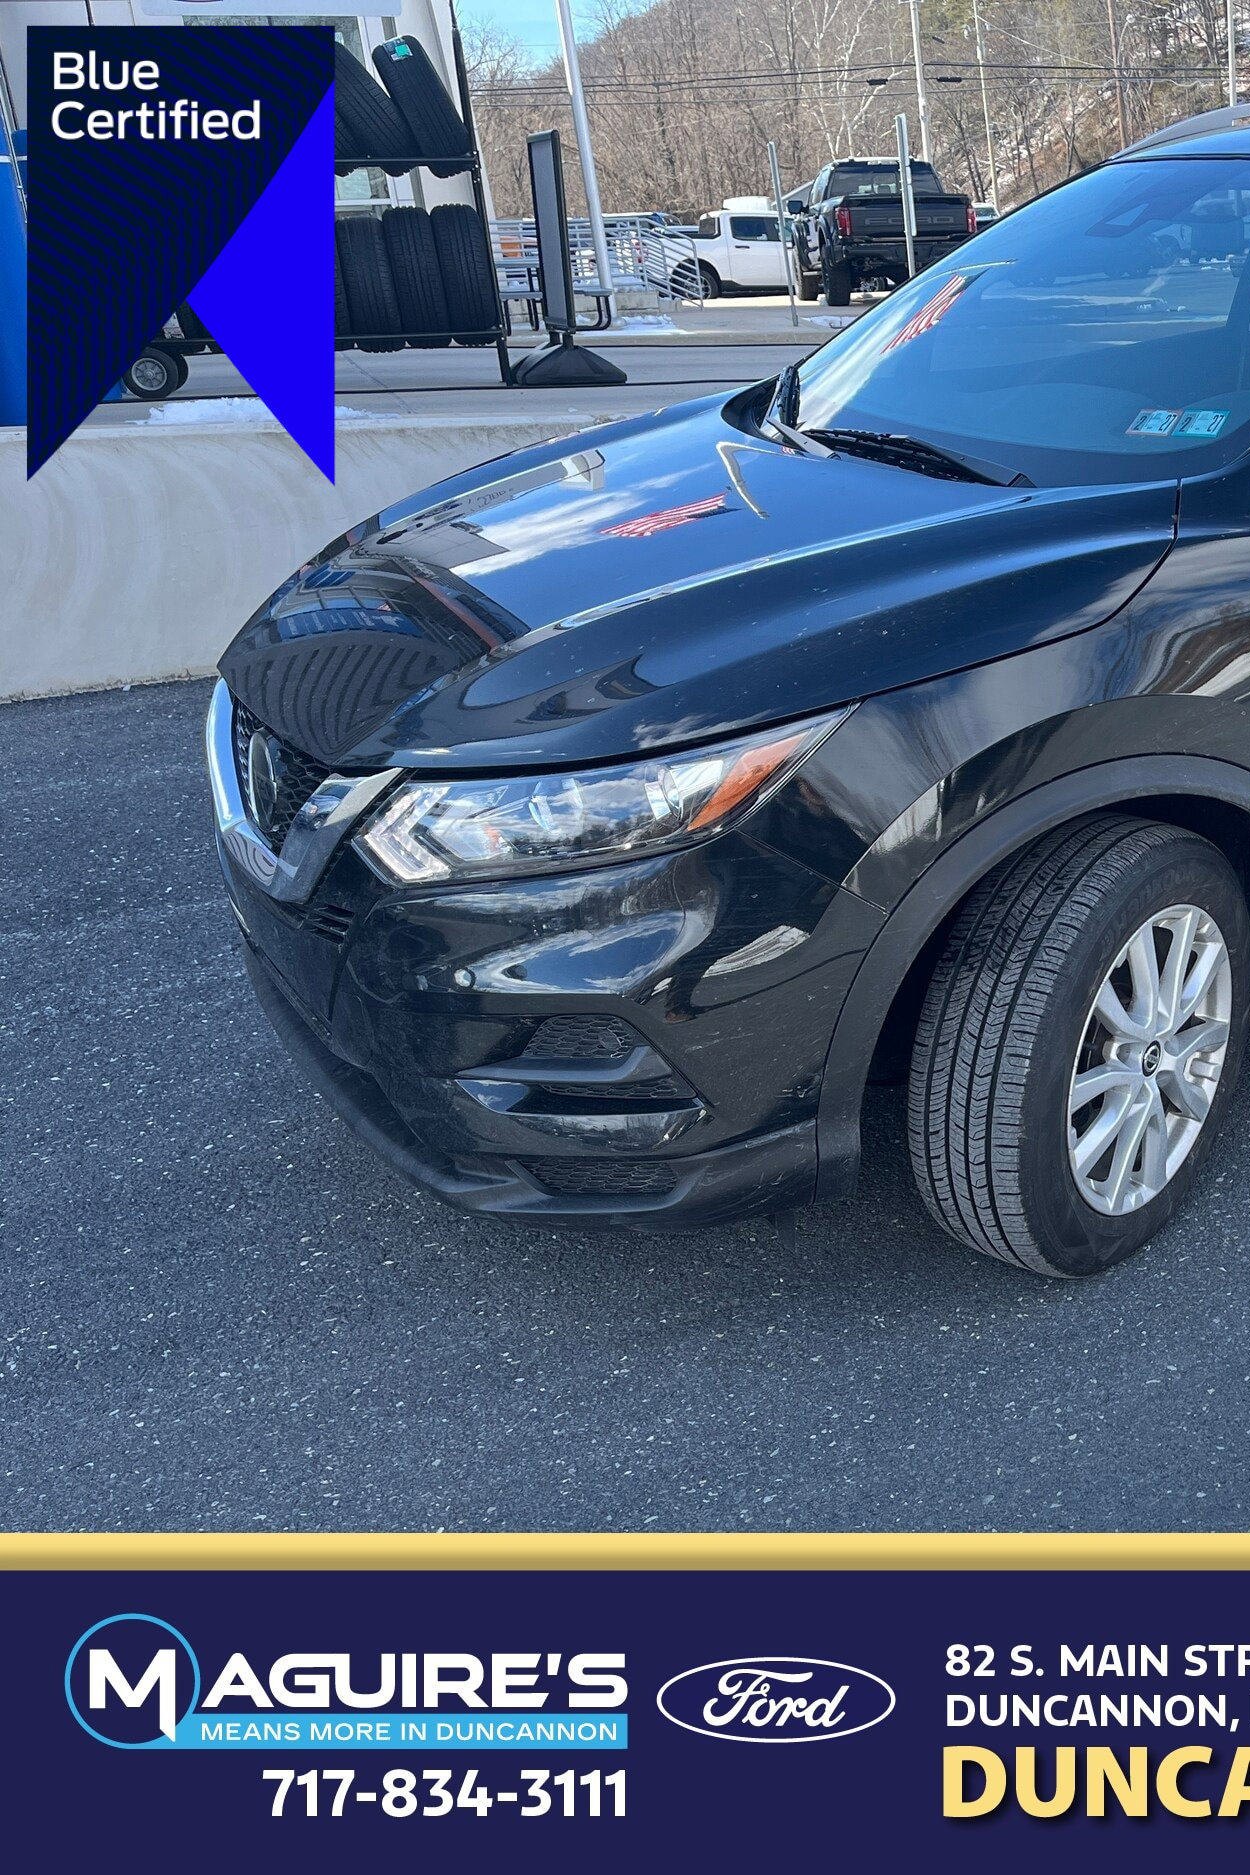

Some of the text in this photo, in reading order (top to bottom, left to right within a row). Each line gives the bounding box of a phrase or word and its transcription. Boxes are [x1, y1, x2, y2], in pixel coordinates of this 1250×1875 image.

[864, 216, 954, 225] FORD
[1133, 415, 1148, 431] 2
[1158, 414, 1178, 432] 27
[1178, 416, 1193, 433] 2
[1206, 414, 1225, 433] 27
